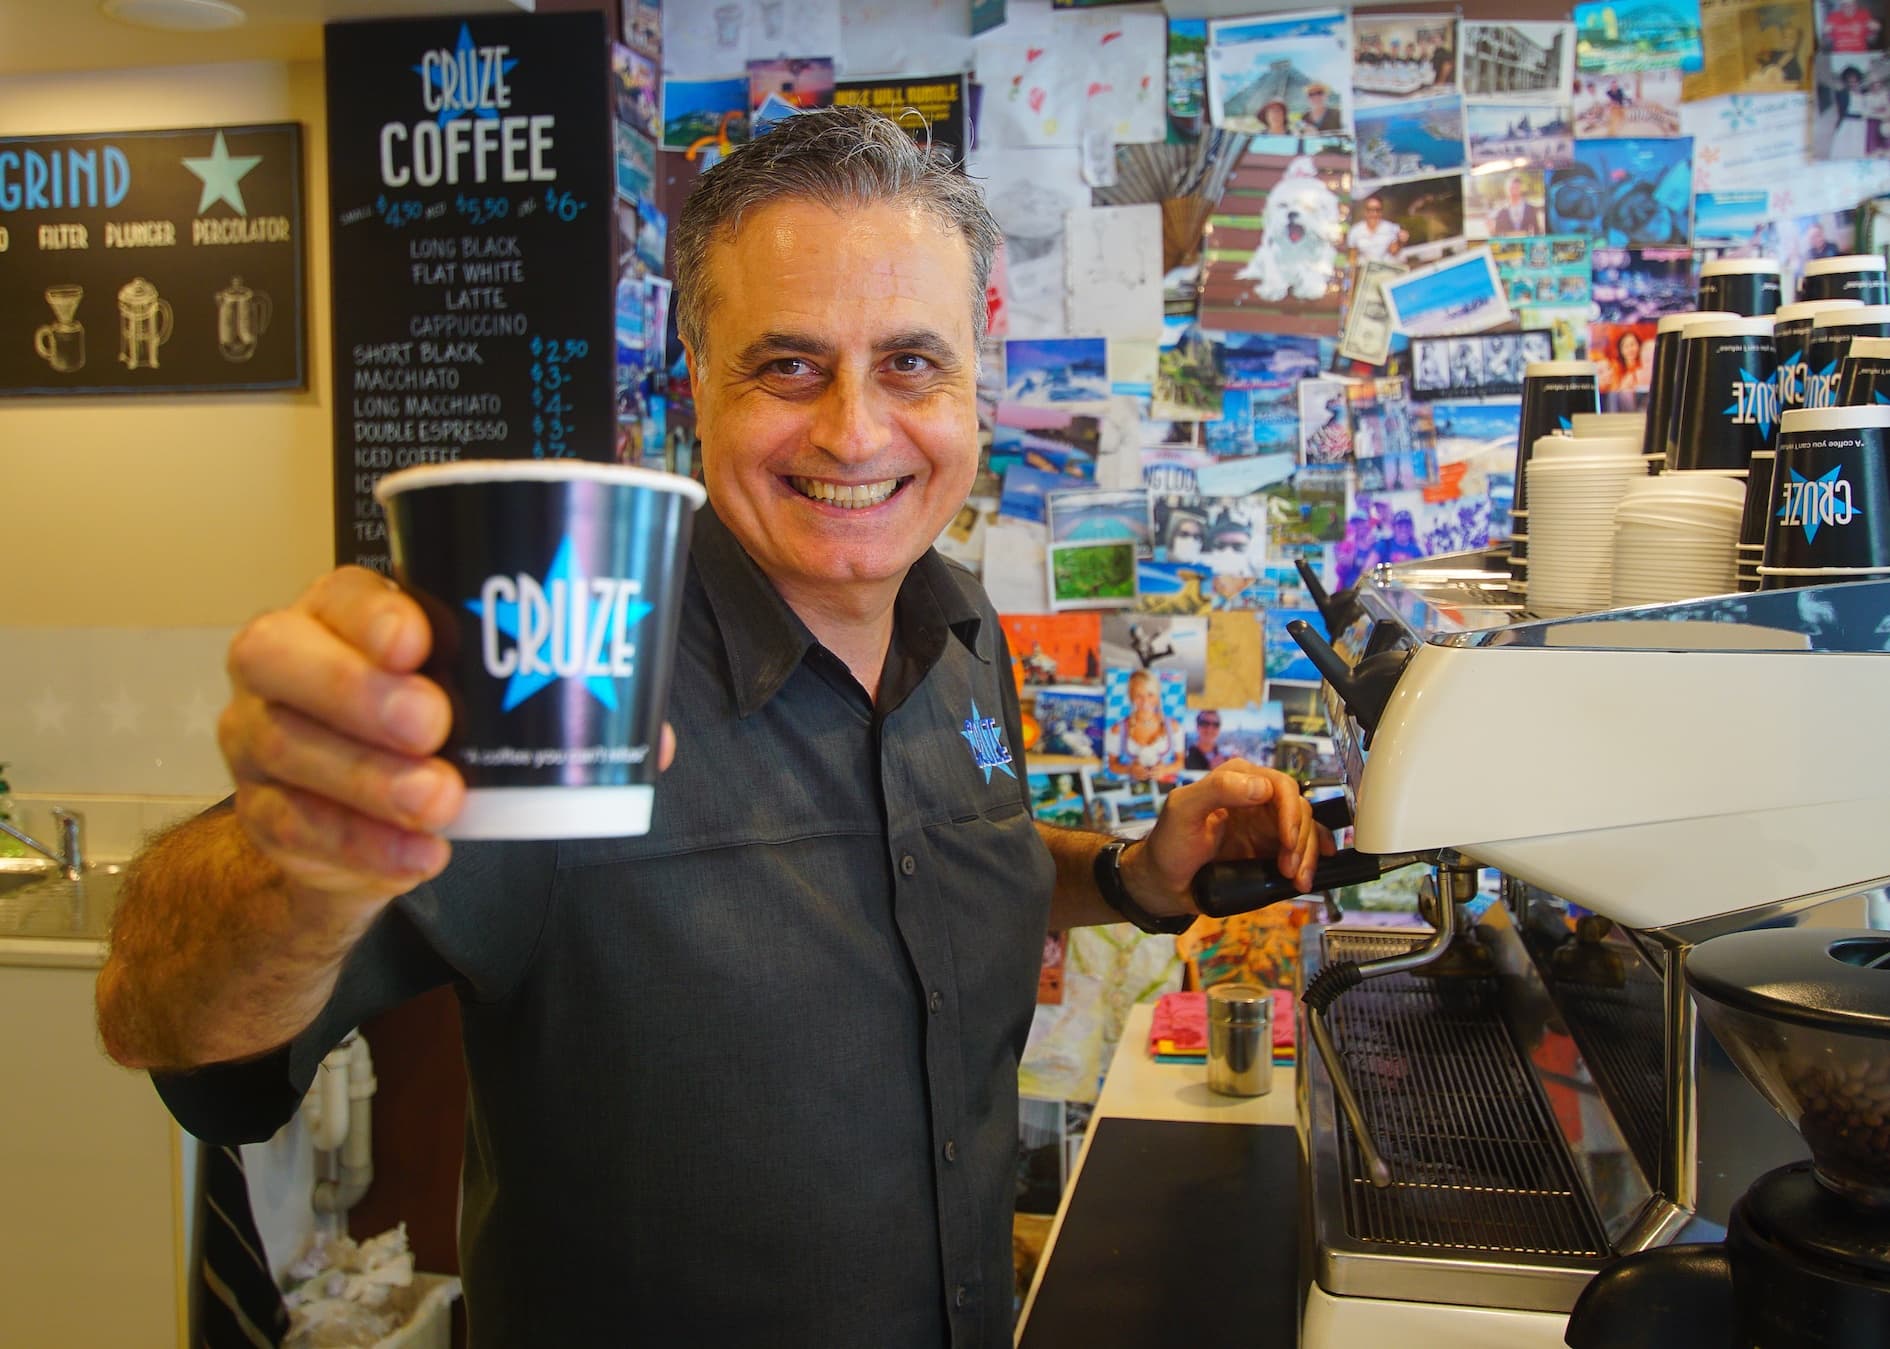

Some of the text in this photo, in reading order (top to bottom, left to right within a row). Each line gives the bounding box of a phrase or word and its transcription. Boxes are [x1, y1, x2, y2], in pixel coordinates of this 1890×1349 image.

[421, 45, 511, 113] CRUZE
[380, 114, 557, 187] COFFEE
[0, 146, 131, 211] GRIND
[38, 223, 89, 250] FILTER
[105, 220, 176, 248] PLUNGER
[192, 216, 291, 246] PERCOLATOR
[411, 236, 521, 258] LONG BLACK
[412, 260, 525, 284] FLAT WHITE
[445, 287, 507, 310] LATTE
[410, 313, 528, 337] CAPPUCCINO
[353, 342, 413, 366] SHORT
[420, 341, 484, 365] BLACK
[354, 368, 459, 391] MACCHIATO
[354, 396, 400, 418] LONG
[405, 394, 501, 418] MACCHIATO
[354, 421, 413, 442] DOUBLE
[418, 420, 508, 444] ESPRESSO
[1812, 440, 1827, 448] you
[1828, 440, 1854, 449] coffee
[354, 447, 393, 468] ICED
[1780, 480, 1852, 527] CRUZE
[482, 571, 641, 680] CRUZE
